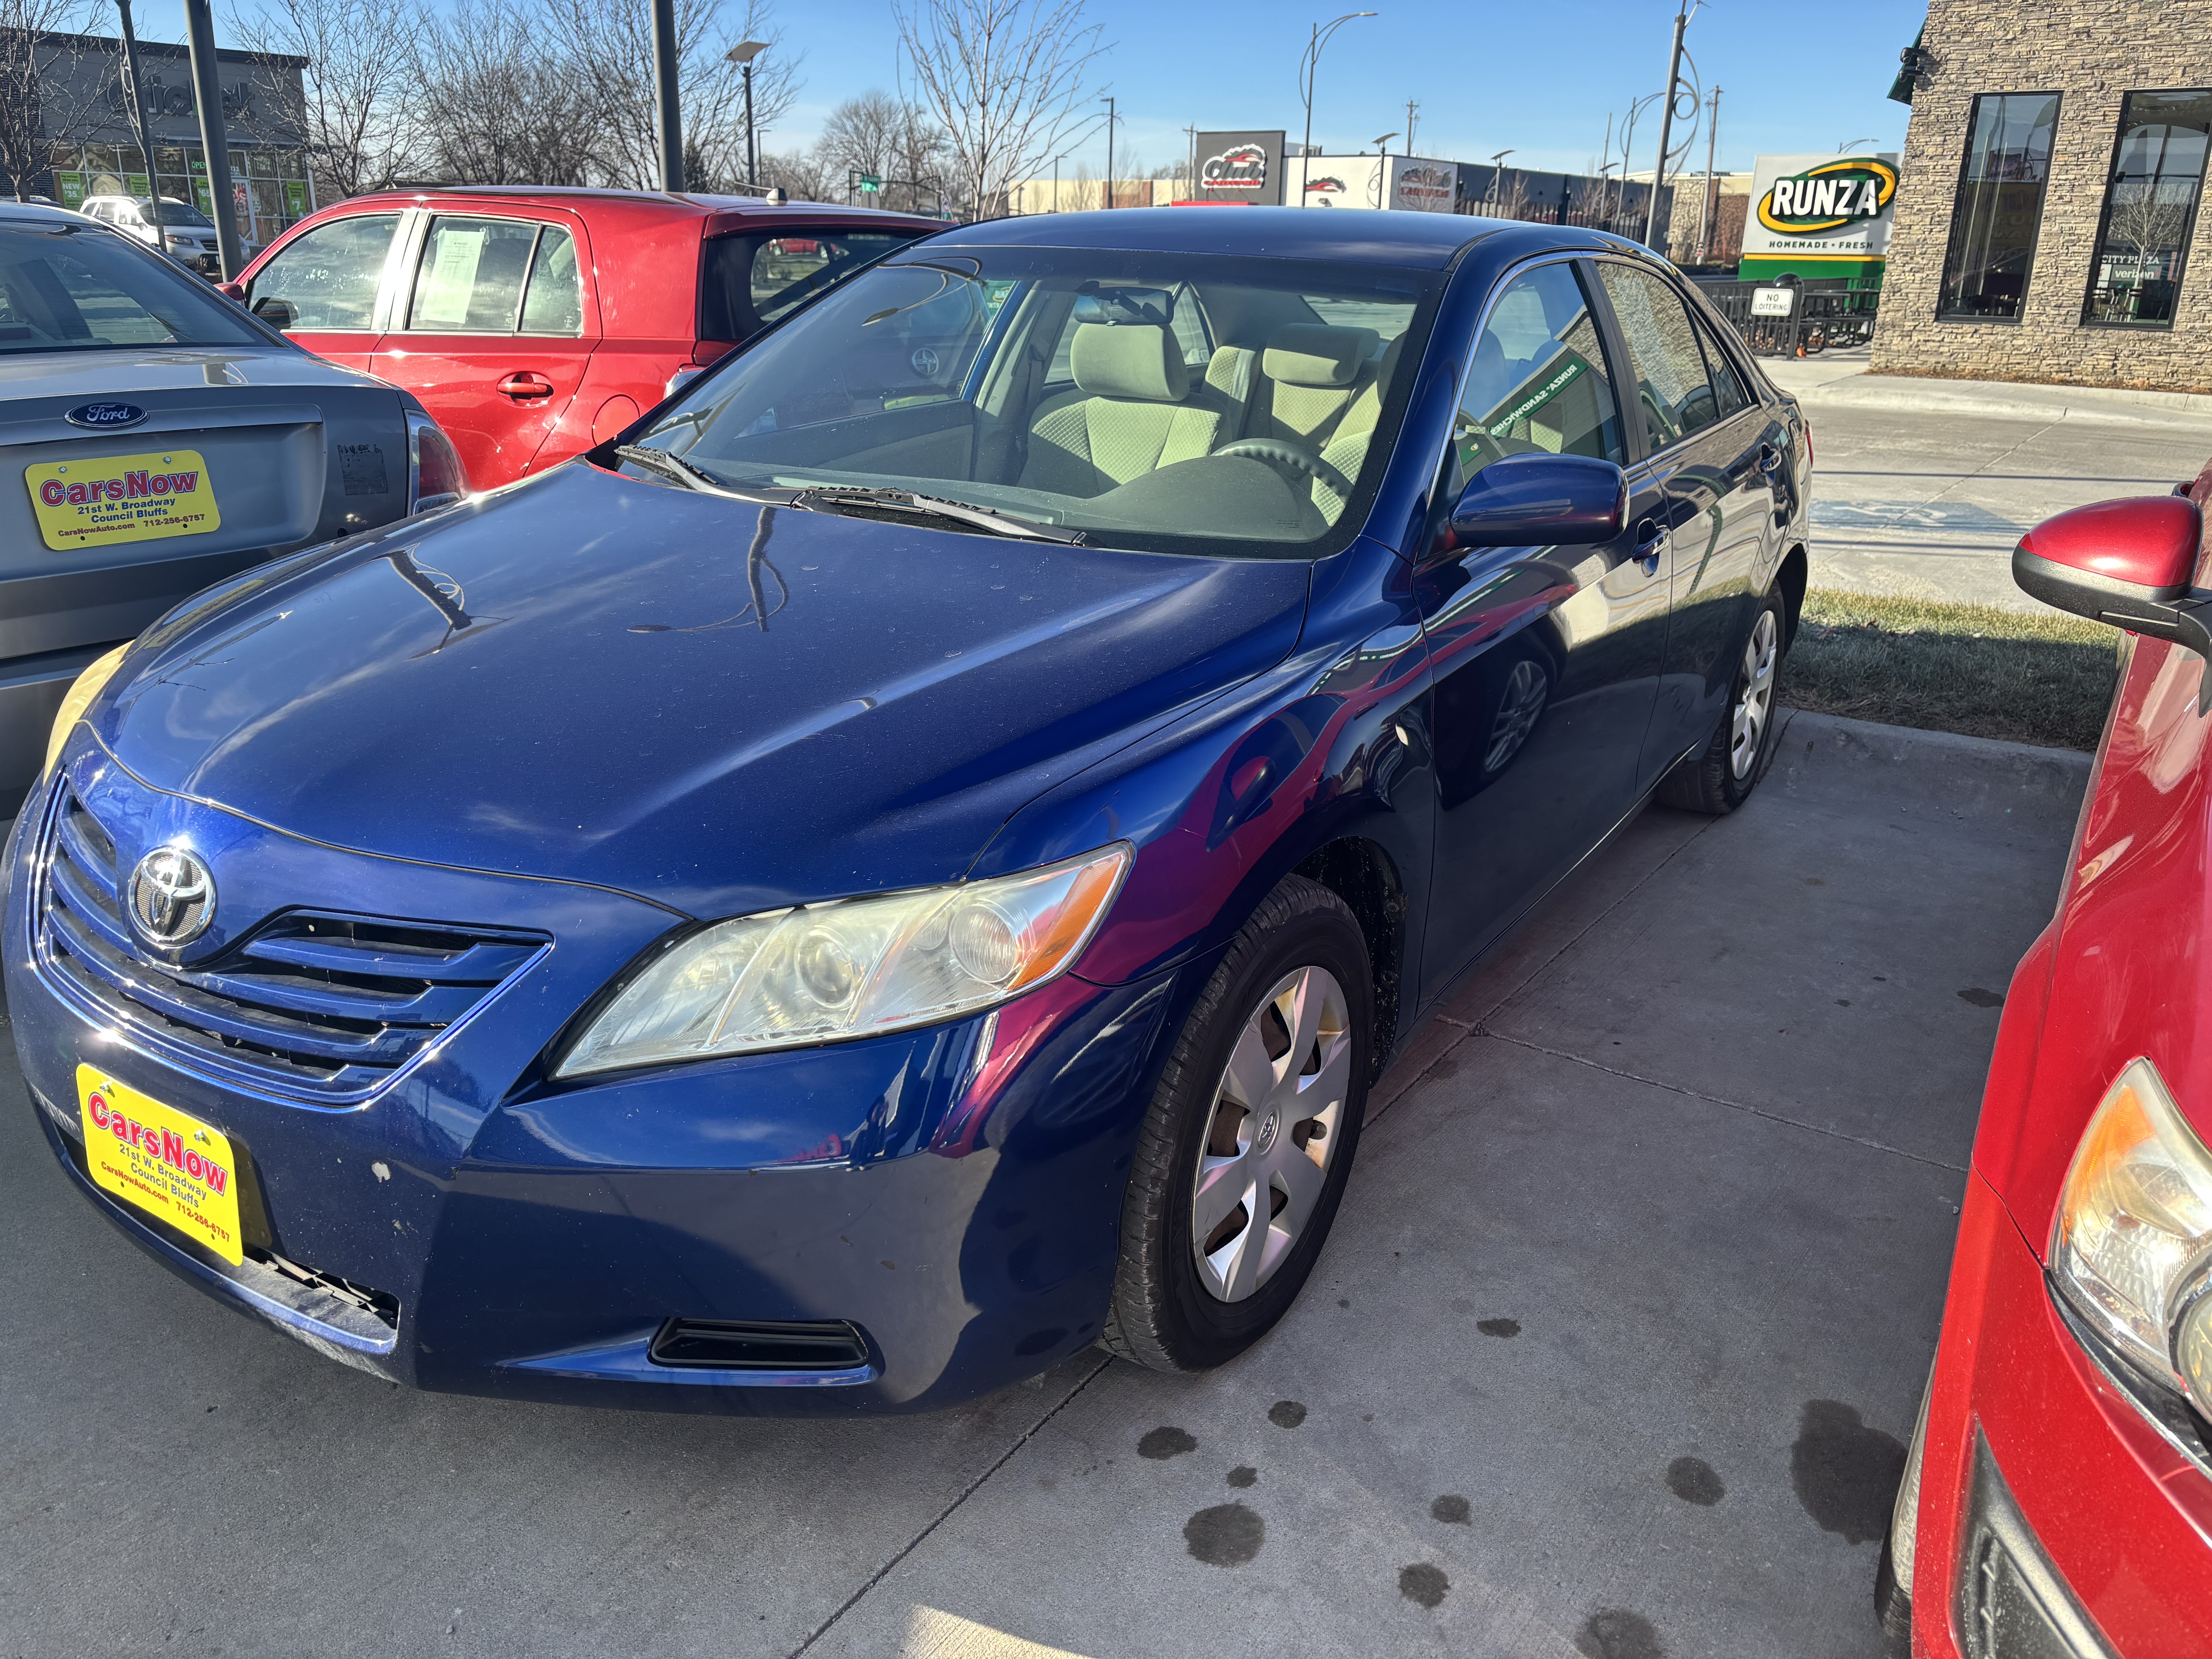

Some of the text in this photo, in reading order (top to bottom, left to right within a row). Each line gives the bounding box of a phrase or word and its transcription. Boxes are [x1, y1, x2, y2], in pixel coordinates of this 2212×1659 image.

[1772, 179, 1876, 215] RUNZA
[1839, 241, 1873, 249] FRESH
[2101, 255, 2159, 264] CITY PLZA
[87, 404, 130, 422] Ford
[40, 470, 198, 507] CarsNow
[78, 498, 175, 515] 21st W. Broadway
[91, 507, 168, 523] Council Bluffs
[58, 514, 205, 537] CarsNowAuto.com 712-256-6757
[88, 1091, 228, 1197] CarsNow
[119, 1143, 207, 1200] 21st W. Broadway
[131, 1162, 199, 1208] Council Bluffs
[101, 1161, 230, 1242] CarsNowAuto.com 712-256-6757
